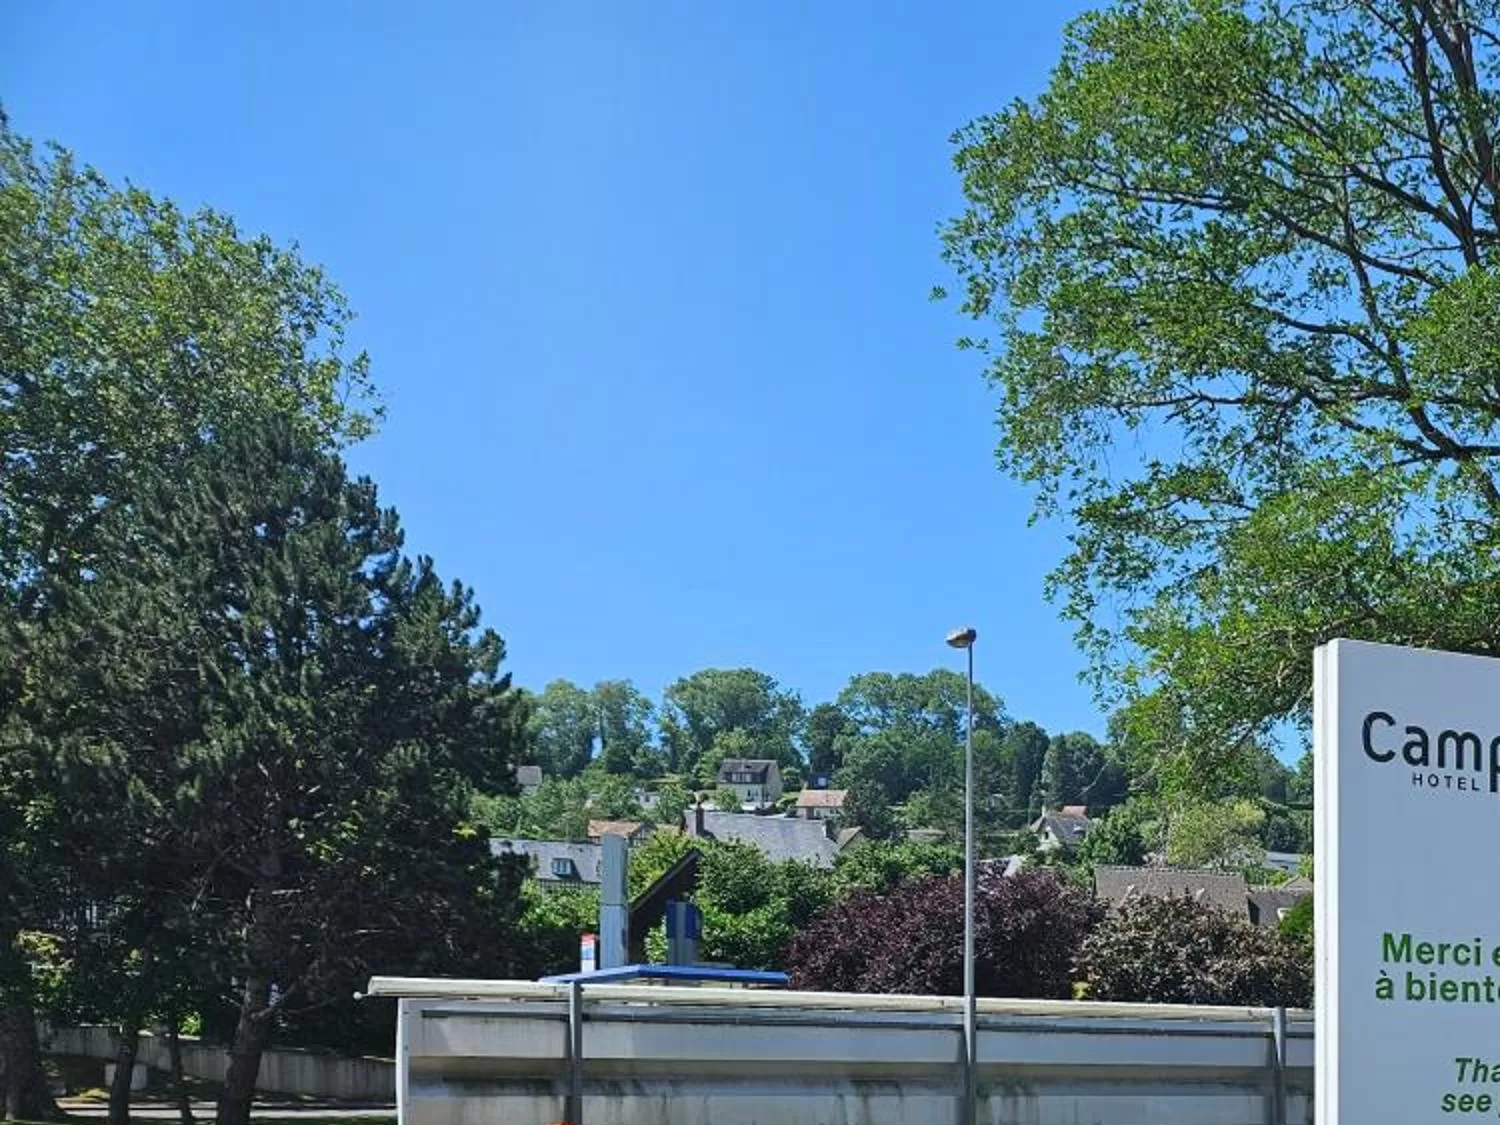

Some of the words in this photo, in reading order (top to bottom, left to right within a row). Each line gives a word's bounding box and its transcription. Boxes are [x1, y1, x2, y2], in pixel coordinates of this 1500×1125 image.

[1412, 771, 1481, 792] HOTEL
[1381, 932, 1482, 967] Merci
[1375, 969, 1394, 1001] à
[1440, 1093, 1493, 1114] see
